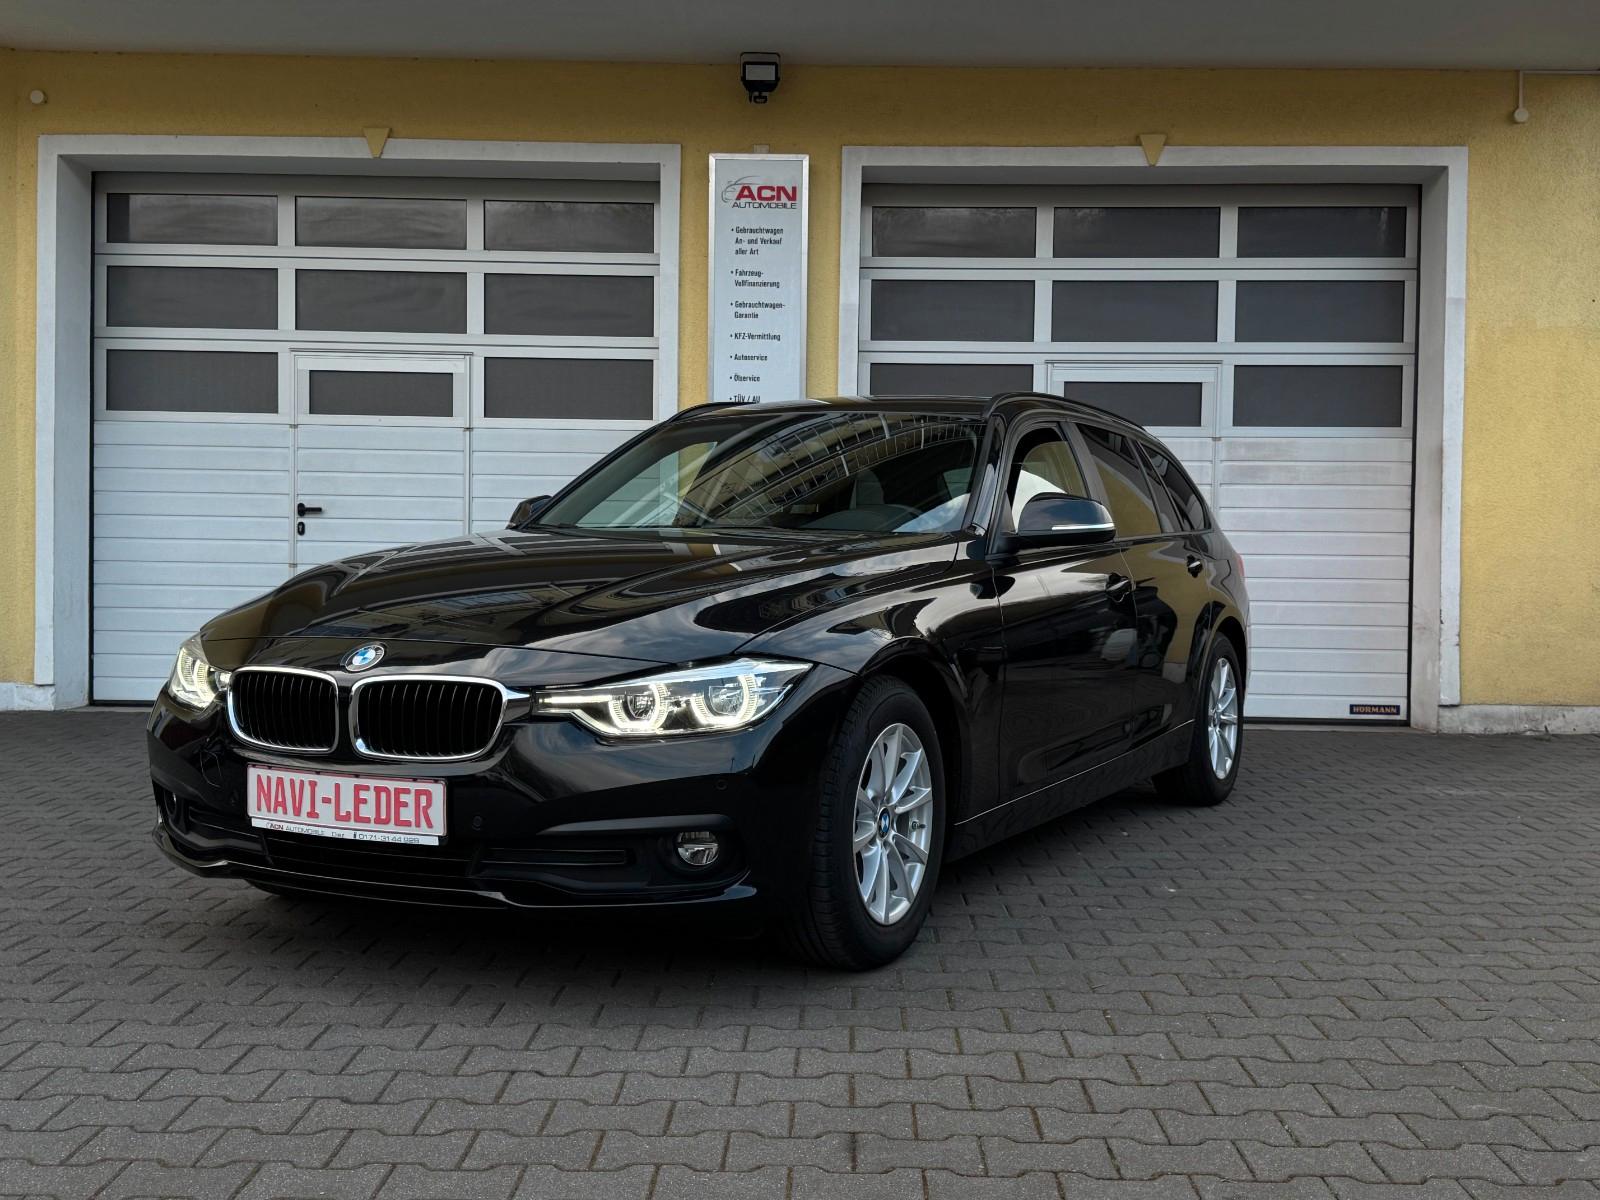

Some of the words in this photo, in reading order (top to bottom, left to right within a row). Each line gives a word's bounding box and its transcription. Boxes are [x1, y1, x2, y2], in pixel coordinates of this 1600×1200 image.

[735, 185, 797, 202] ACN
[732, 201, 797, 210] AUTOMOBILE
[735, 226, 784, 236] Gebrauchtwagen
[735, 237, 746, 245] An-
[760, 237, 783, 245] Verkauf
[735, 248, 748, 256] aller
[749, 248, 759, 256] Art
[735, 269, 764, 278] Fahrzeug-
[734, 280, 780, 289] Vollfinanzierung
[734, 301, 786, 310] Gebrauchtwagen-
[734, 311, 759, 319] Garantie
[734, 332, 781, 342] KFZ-Vermittlung
[734, 353, 768, 361] Autoservice
[256, 774, 434, 829] NAVI-LEDER
